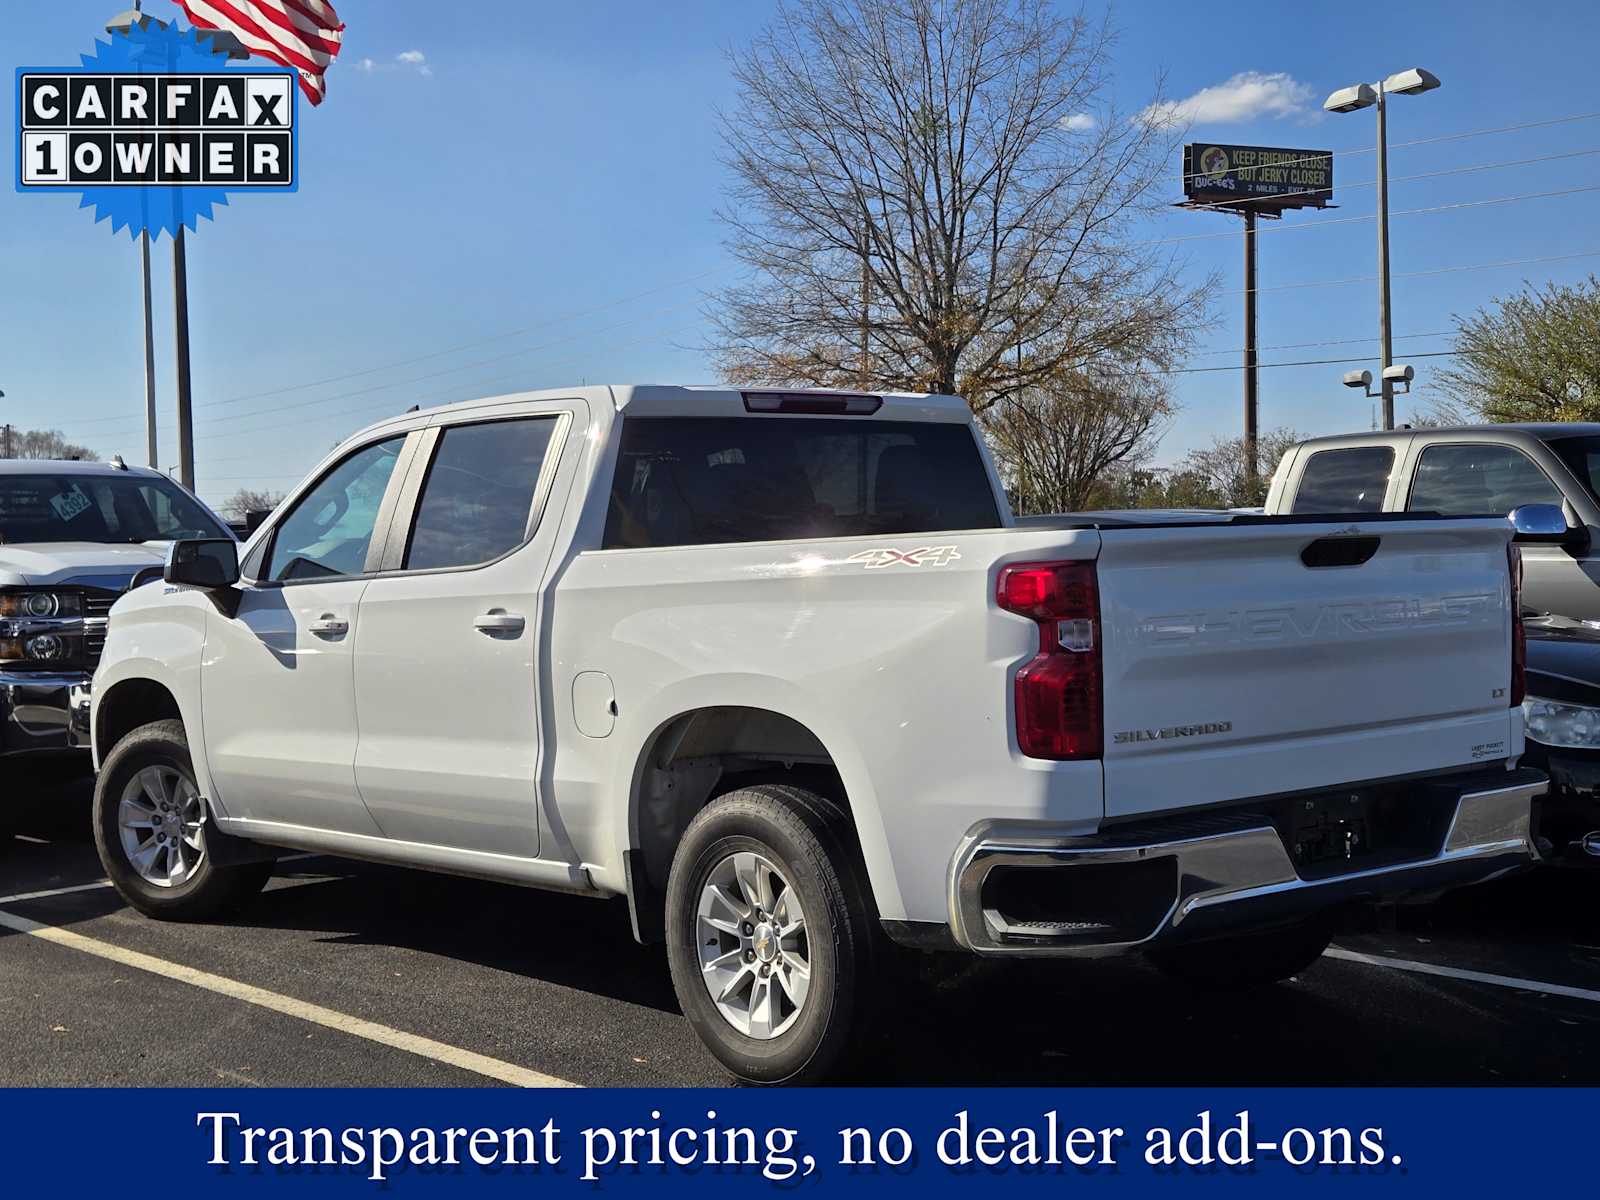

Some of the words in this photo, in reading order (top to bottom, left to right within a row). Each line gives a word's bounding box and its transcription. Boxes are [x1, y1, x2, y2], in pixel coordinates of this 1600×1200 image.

[1232, 150, 1256, 165] KEEP
[1259, 152, 1297, 168] FRIENDS
[1238, 167, 1257, 181] BUT
[1258, 168, 1288, 183] JERKY
[1290, 169, 1325, 185] CLOSER
[1256, 185, 1278, 193] MILES
[1113, 721, 1232, 744] SILVERADO
